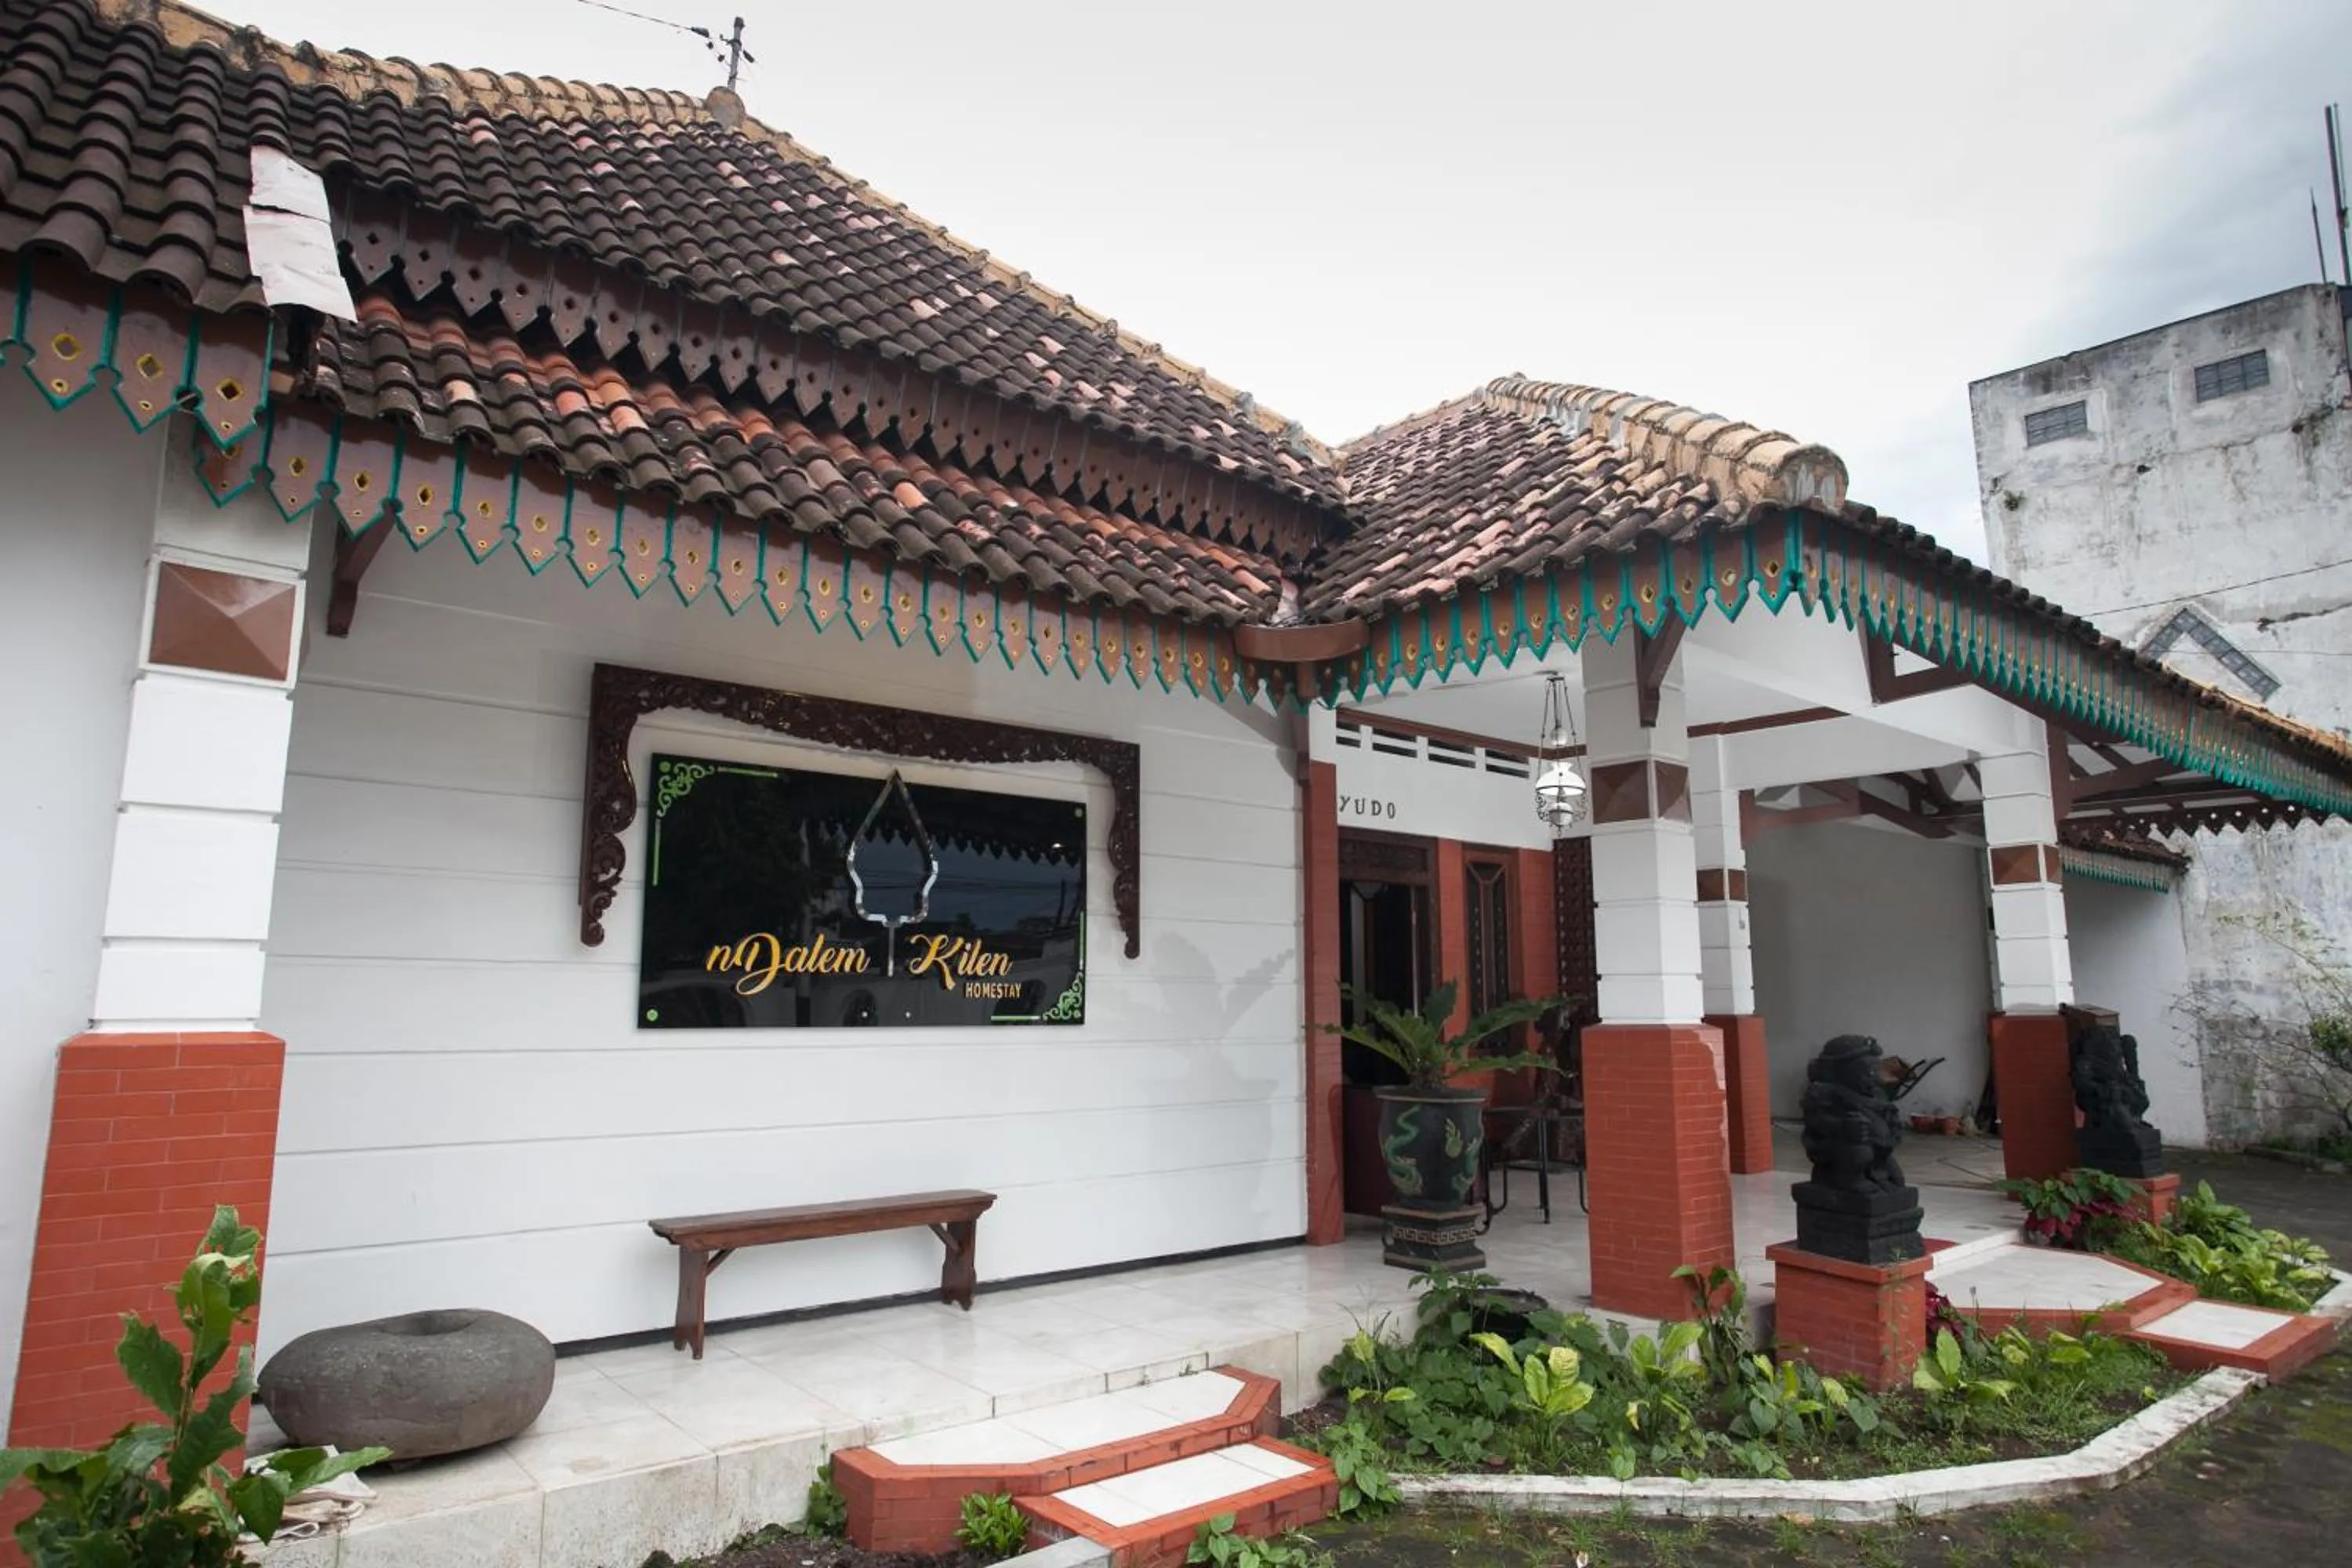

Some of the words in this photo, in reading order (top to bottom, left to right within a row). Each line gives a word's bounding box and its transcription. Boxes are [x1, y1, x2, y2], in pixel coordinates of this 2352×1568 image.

[1339, 795, 1396, 819] YUDO
[706, 932, 871, 996] nDalem
[909, 934, 1013, 991] Kilen
[965, 982, 1022, 999] HOMESTAY
